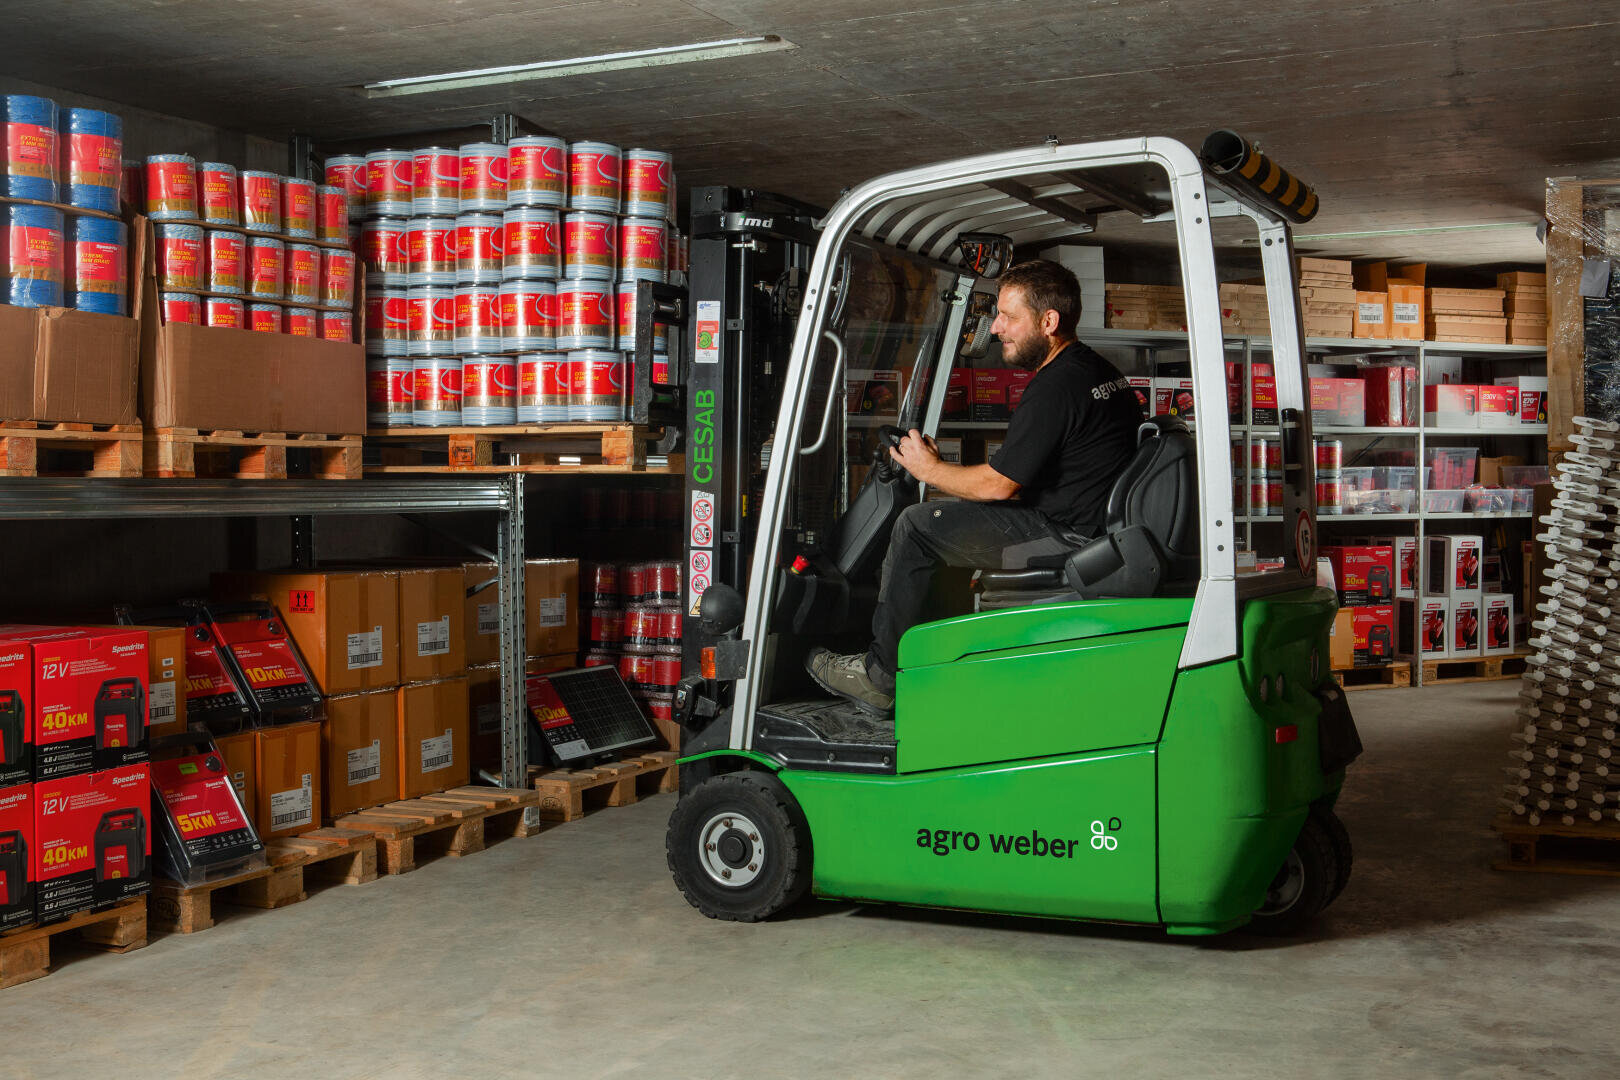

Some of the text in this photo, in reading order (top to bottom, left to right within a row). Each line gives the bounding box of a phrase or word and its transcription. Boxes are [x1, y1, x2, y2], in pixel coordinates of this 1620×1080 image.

[738, 215, 774, 229] imd
[1091, 380, 1117, 400] agro
[693, 389, 716, 484] CESAB
[112, 643, 145, 654] Speedrite
[0, 652, 25, 663] eedrite
[112, 772, 146, 786] Speedrite
[0, 792, 28, 805] eedrite
[916, 828, 1079, 859] agro weber
